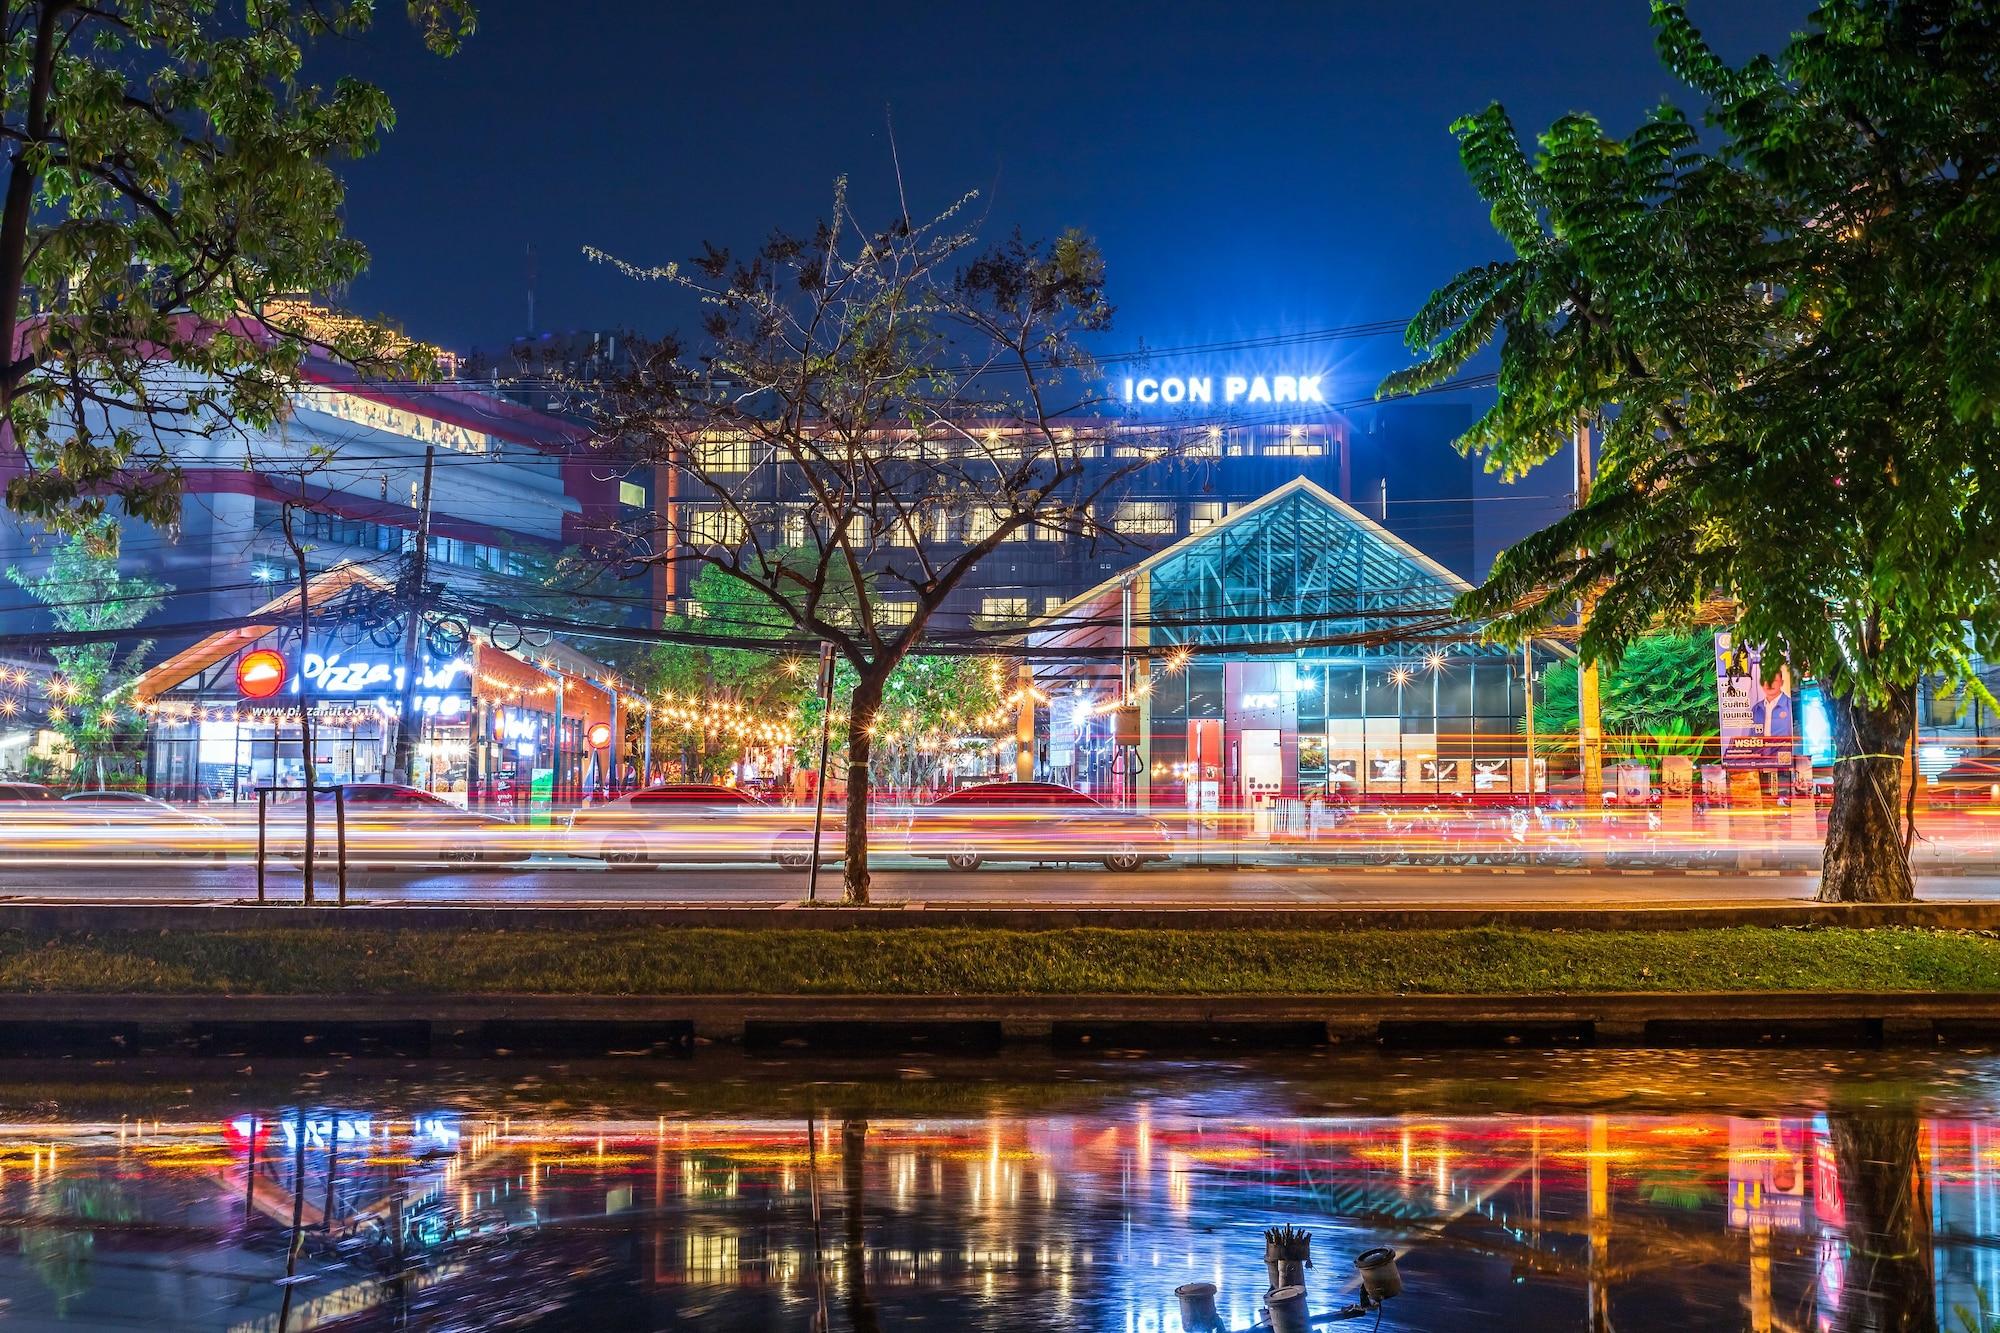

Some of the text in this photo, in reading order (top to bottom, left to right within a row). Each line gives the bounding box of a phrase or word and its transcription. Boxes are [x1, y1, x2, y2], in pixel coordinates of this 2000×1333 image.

[1125, 375, 1323, 402] ICON PARK
[290, 653, 392, 693] Pizza
[252, 705, 377, 719] www.pizahut.co.th
